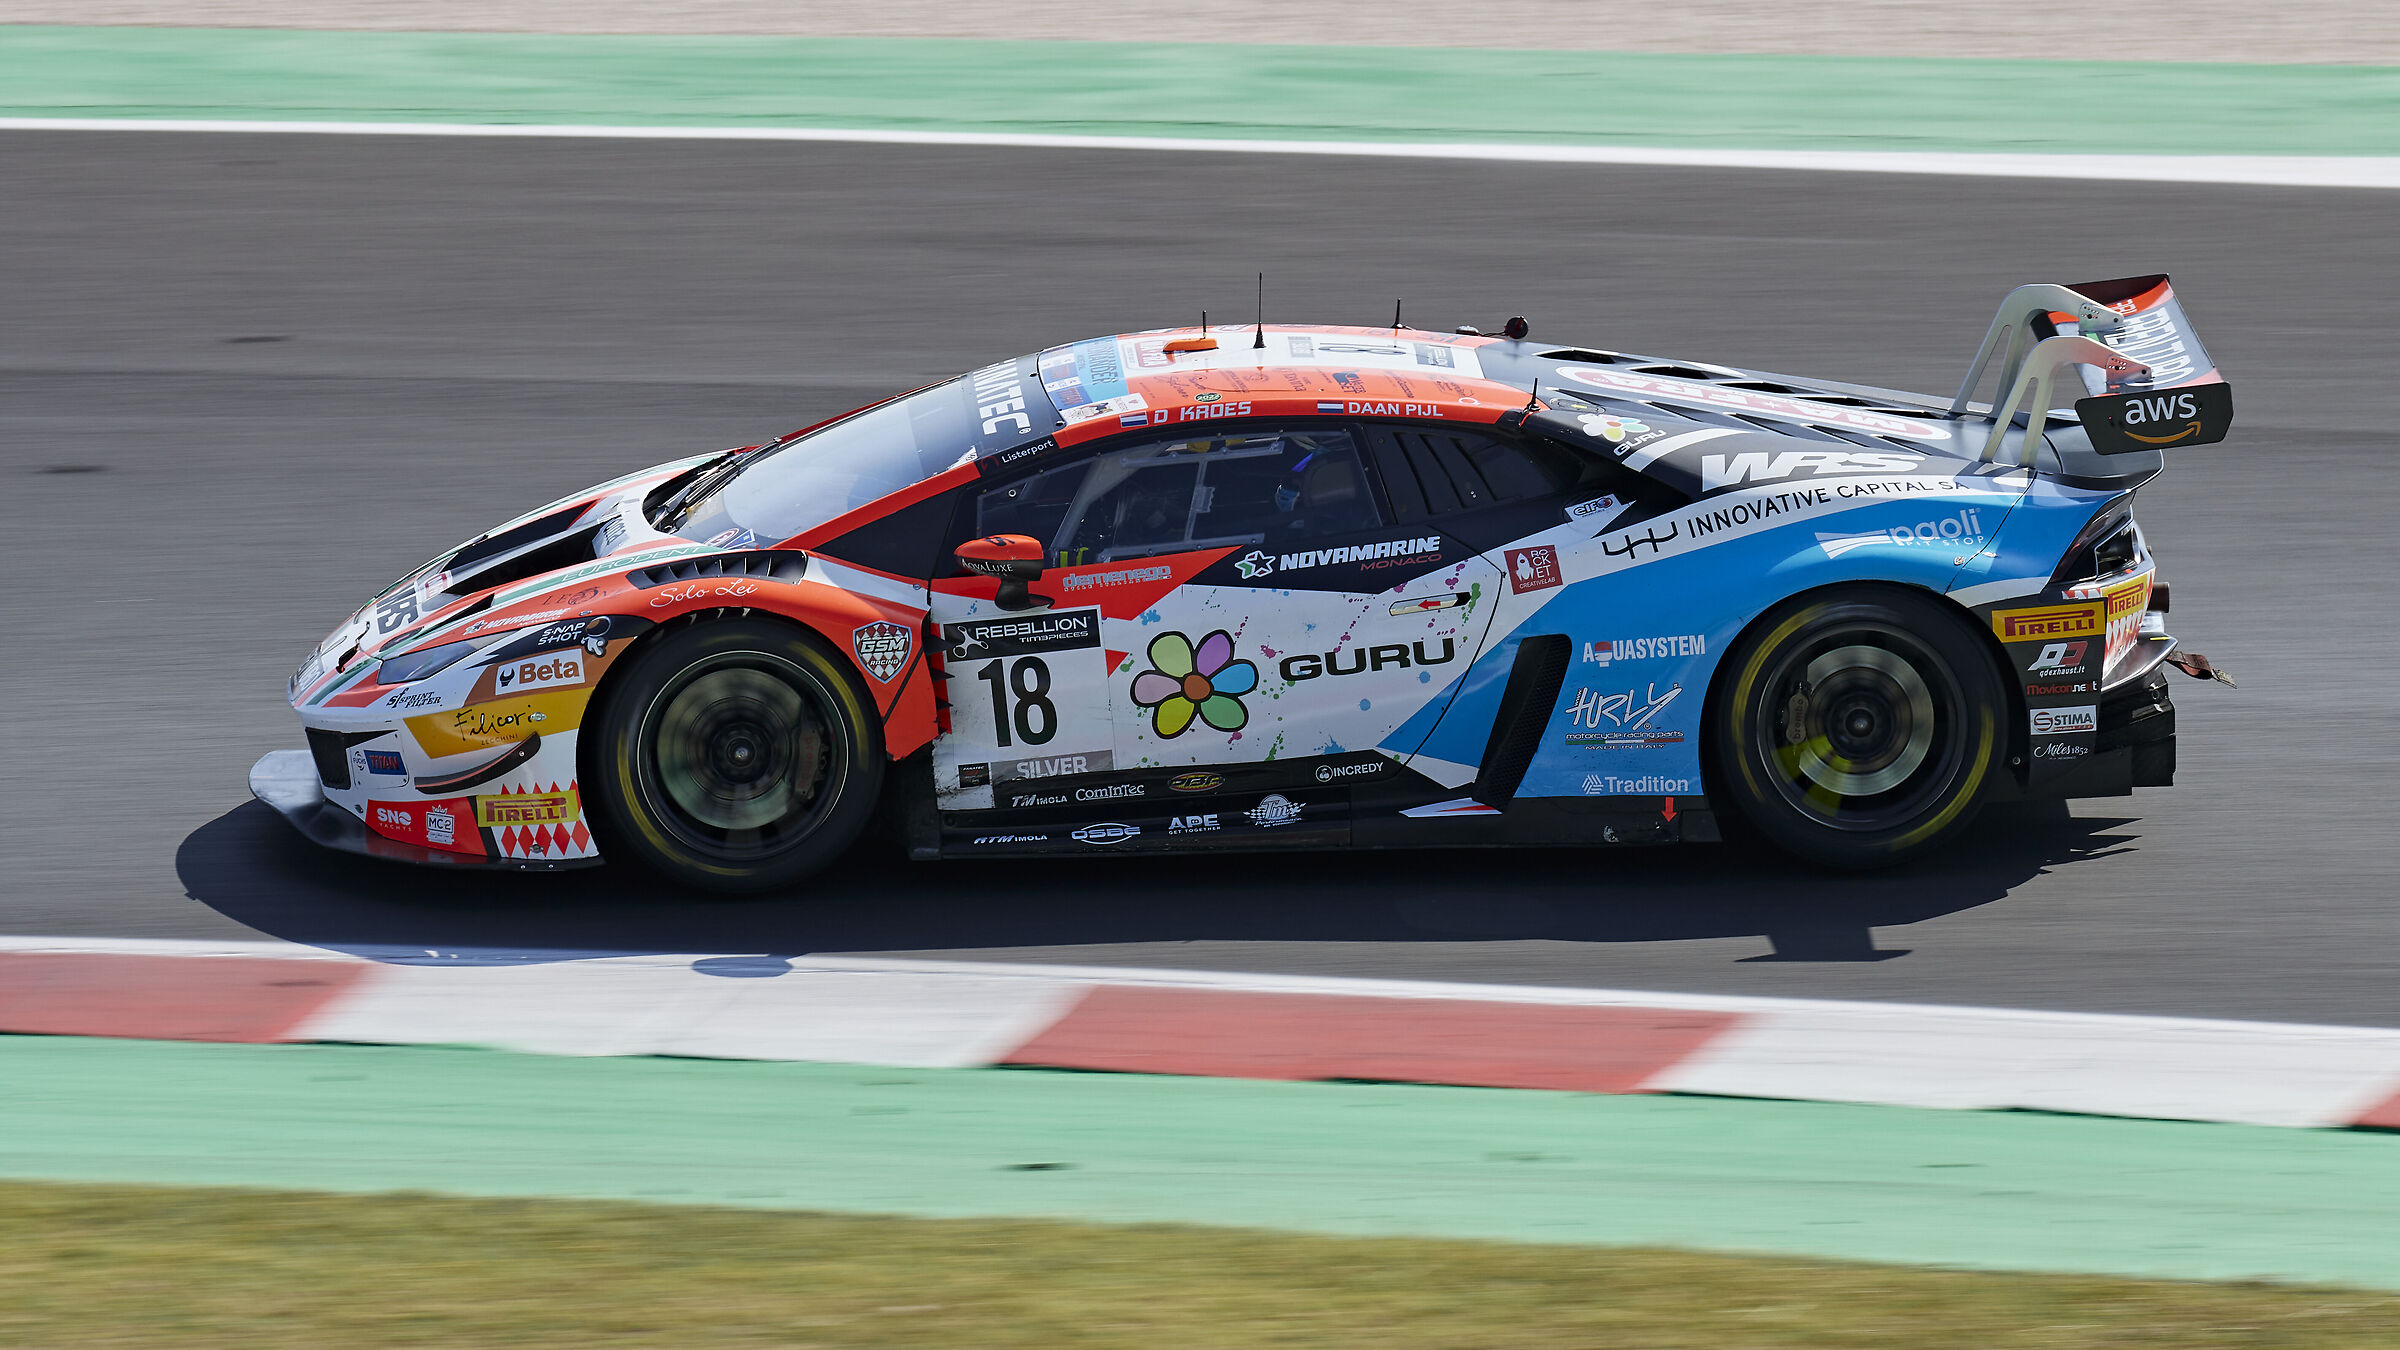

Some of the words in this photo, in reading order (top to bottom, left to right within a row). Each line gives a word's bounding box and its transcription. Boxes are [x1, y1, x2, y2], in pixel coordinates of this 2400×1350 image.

[972, 358, 1030, 436] ANATEC
[1154, 410, 1169, 424] D
[1180, 401, 1252, 422] KROES
[1348, 402, 1400, 415] DAAN
[1406, 404, 1444, 417] PIJL
[2125, 393, 2197, 426] aws
[1001, 439, 1054, 464] Listerport
[1613, 429, 1667, 456] GURU
[1702, 452, 1926, 492] WRS
[1687, 487, 1832, 539] INNOVATIVE
[1836, 481, 1934, 499] CAPITAL
[1938, 481, 1970, 491] SA
[1890, 508, 1982, 547] paoli
[1943, 535, 1985, 547] STOP
[561, 547, 701, 582] EURODENT
[1279, 535, 1441, 571] NOVAMARINE
[1360, 553, 1442, 572] MONACO
[1063, 565, 1171, 588] demenego
[1519, 577, 1556, 590] CREATIVELAB
[650, 585, 710, 608] Solo
[714, 578, 759, 597] Lei
[2108, 583, 2145, 616] PIRELLI
[975, 616, 1088, 640] REBELLION
[2005, 609, 2095, 637] PIRELLI
[861, 638, 907, 653] GSM
[519, 658, 580, 685] Beta
[870, 658, 899, 666] RACING
[1279, 638, 1456, 682] GURU
[977, 655, 1058, 748] 18
[454, 705, 533, 741] Filicori
[2054, 713, 2093, 726] STIMA
[1565, 732, 1622, 740] motorcycle
[1623, 731, 1655, 740] racing
[1657, 730, 1684, 739] parts
[2033, 742, 2071, 758] Miles
[369, 755, 399, 770] TITAN
[1015, 755, 1089, 780] SILVER
[1333, 761, 1385, 777] INCREDY
[1075, 784, 1145, 801] ComInTec
[1605, 775, 1689, 793] Tradition
[485, 797, 568, 822] PIRELLI
[1037, 795, 1068, 806] IMOLA
[379, 823, 412, 832] YACHTS
[428, 816, 452, 830] MC2
[1168, 813, 1220, 830] APE
[1185, 826, 1221, 834] TOGETHER
[1015, 833, 1048, 842] IMOLA
